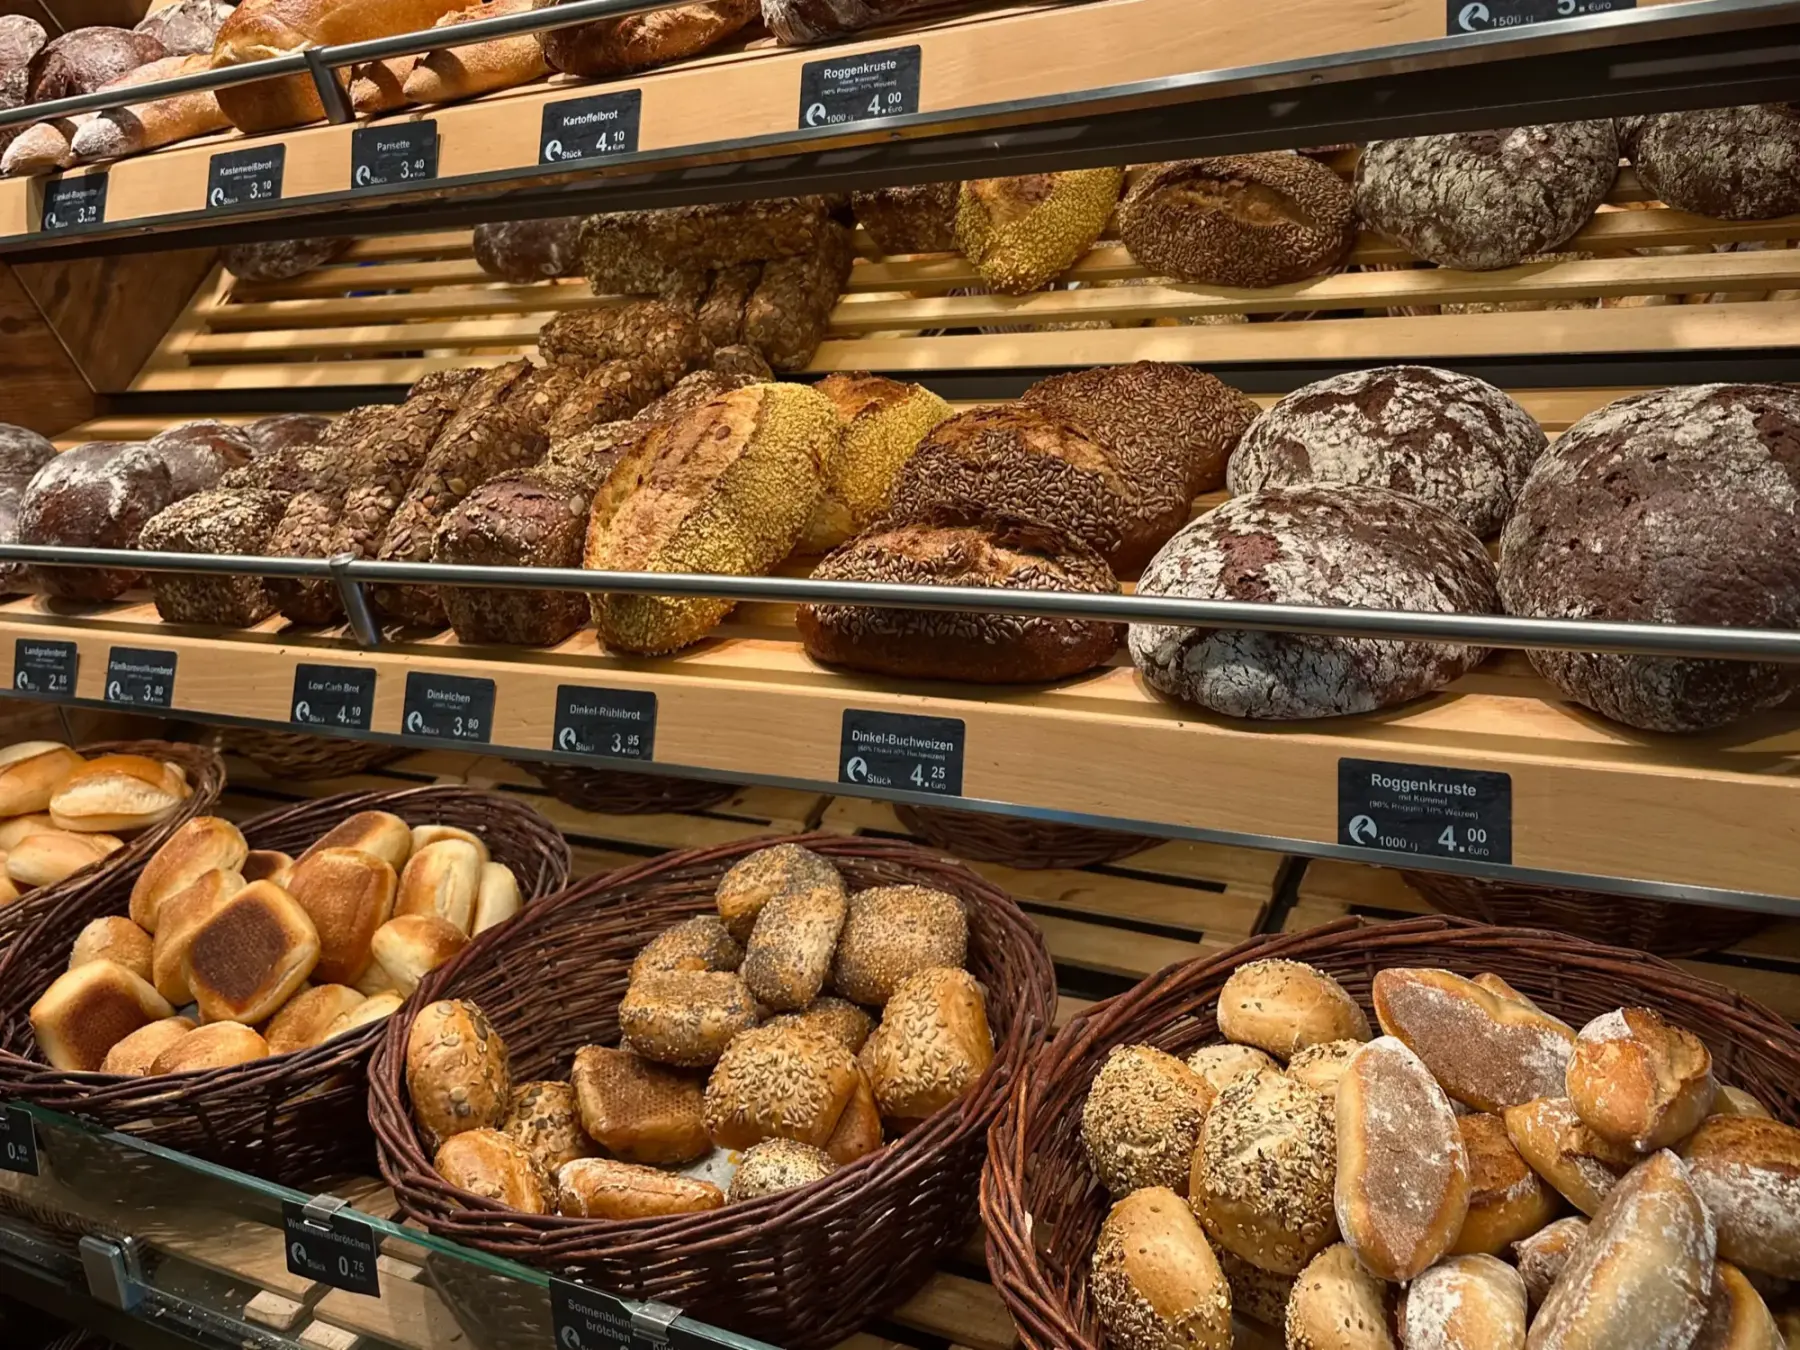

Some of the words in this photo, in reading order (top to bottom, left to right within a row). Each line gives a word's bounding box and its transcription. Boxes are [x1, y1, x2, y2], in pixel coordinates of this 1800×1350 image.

[1491, 15, 1521, 27] 1500
[824, 60, 897, 80] Roggenkruste
[563, 109, 619, 127] Kartoffelbrot
[826, 113, 846, 124] 1000
[561, 149, 583, 160] Stück
[220, 160, 272, 176] Kastenweißbrot
[308, 680, 324, 690] Low
[325, 681, 342, 691] Carb
[343, 683, 360, 694] Brot
[427, 688, 471, 703] Dinkelchen
[570, 704, 640, 720] Dinkel-Rüblibrot
[852, 729, 953, 752] Dinkel-Buchweizen
[867, 773, 892, 785] Stück
[1371, 773, 1477, 797] Roggenkruste
[1398, 793, 1411, 801] mit
[1369, 800, 1389, 809] (90%
[1444, 807, 1479, 820] Weizen)
[1379, 835, 1407, 849] 1000
[586, 1319, 631, 1344] brötchen
